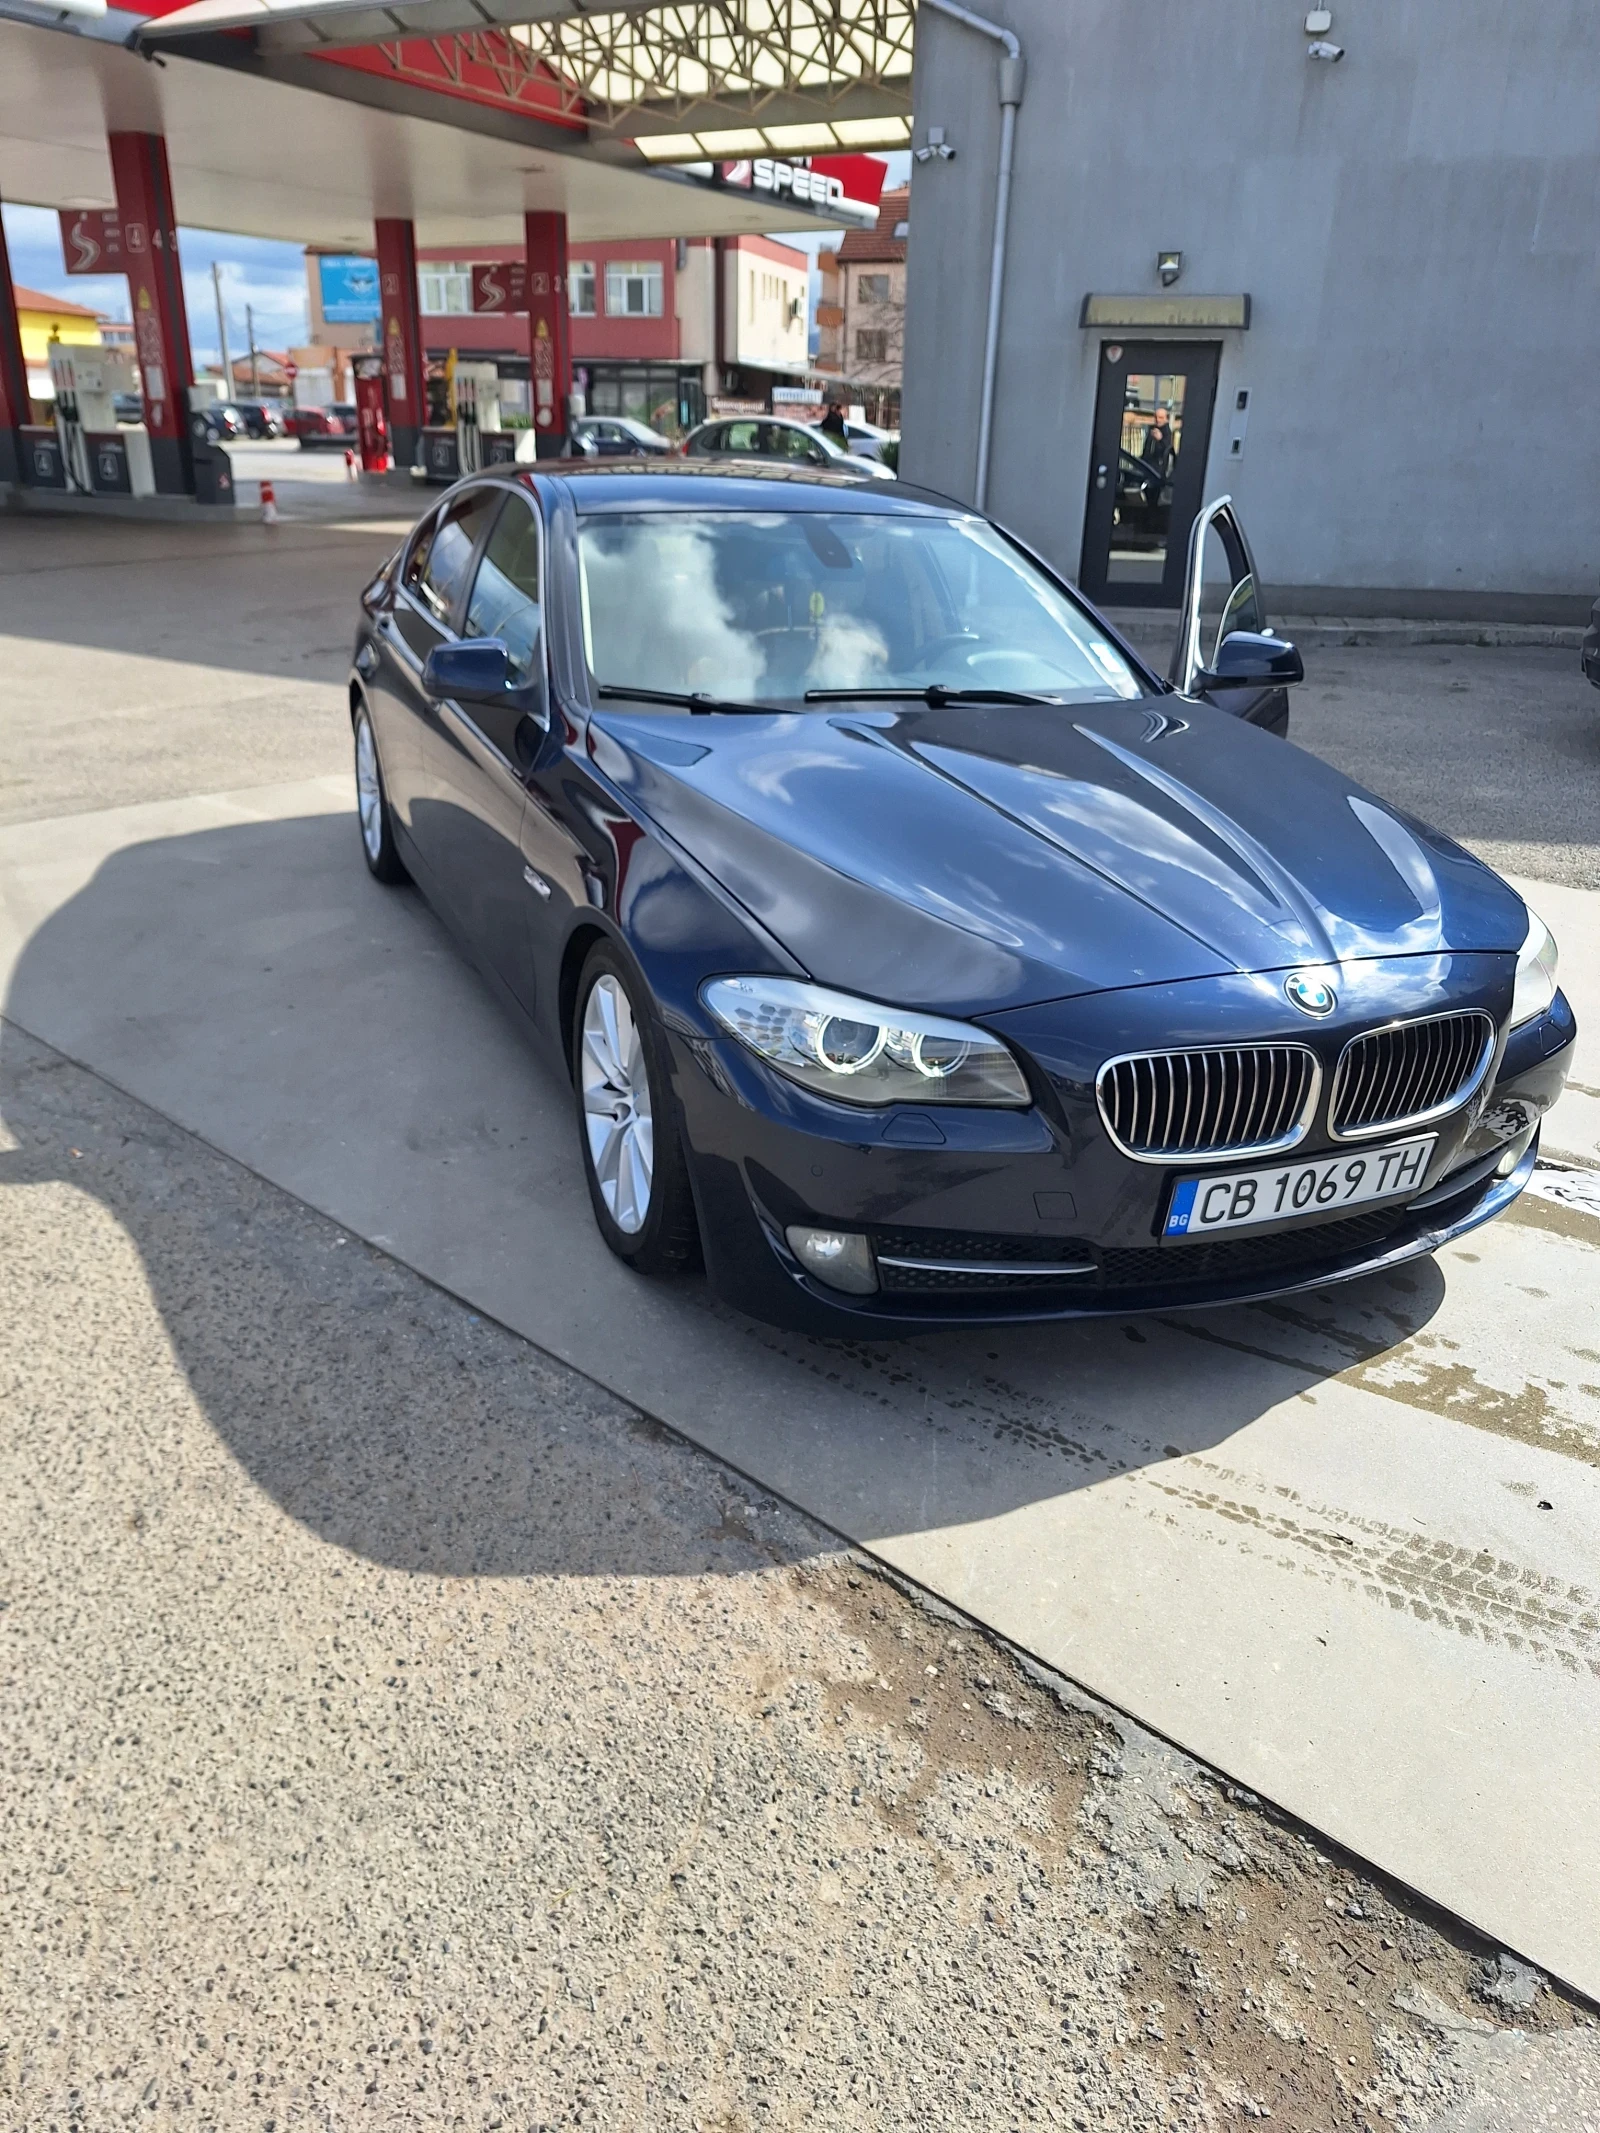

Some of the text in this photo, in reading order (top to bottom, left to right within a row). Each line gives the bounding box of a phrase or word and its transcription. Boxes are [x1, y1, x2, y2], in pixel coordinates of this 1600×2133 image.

[753, 158, 844, 205] SPEED
[1200, 1146, 1426, 1224] CB 1069 TH
[1169, 1214, 1188, 1228] BG
